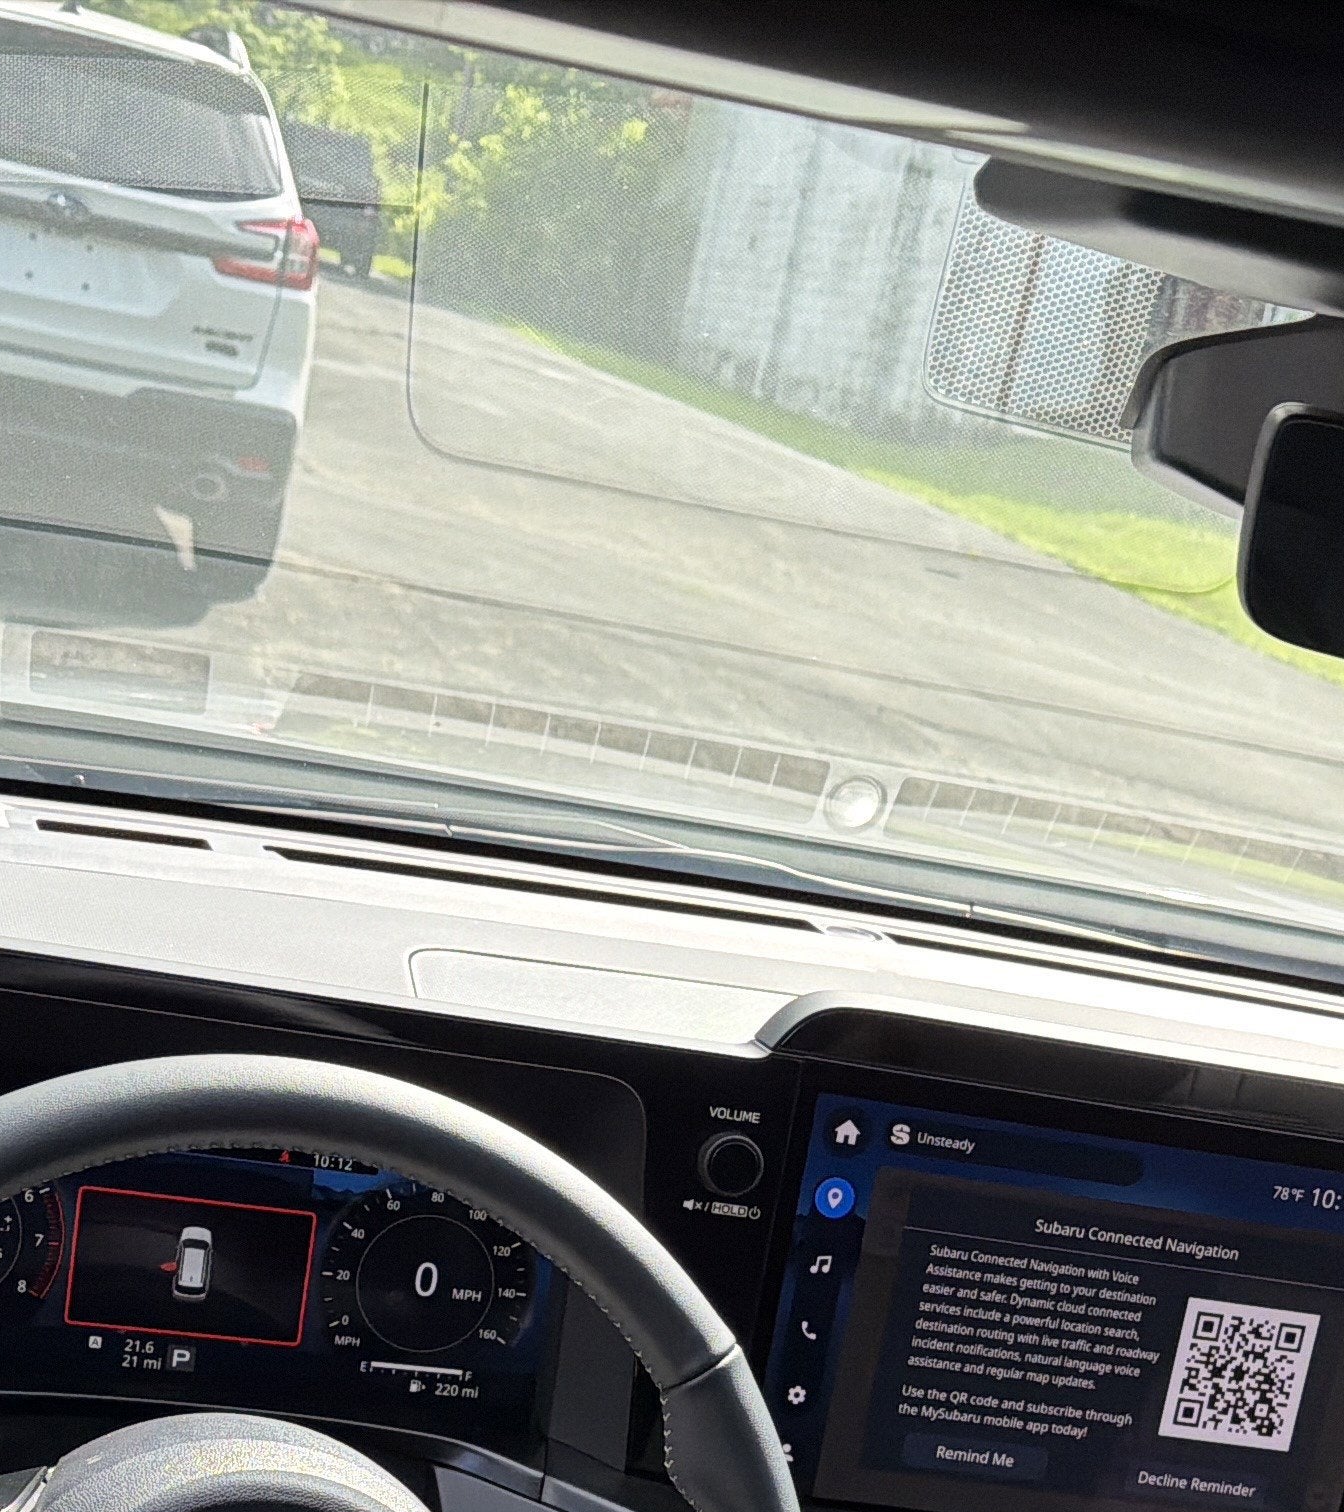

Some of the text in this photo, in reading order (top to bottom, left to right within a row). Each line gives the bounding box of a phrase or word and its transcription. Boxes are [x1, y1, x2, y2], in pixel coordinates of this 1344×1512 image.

[709, 1105, 761, 1125] VOLUME
[917, 1131, 976, 1155] Unsteady
[313, 1154, 354, 1171] 10:12
[24, 1189, 34, 1203] 6
[431, 1192, 445, 1203] 80
[387, 1200, 401, 1211] 60
[711, 1202, 748, 1217] HOLD
[468, 1209, 488, 1221] 100
[34, 1233, 44, 1247] 7
[351, 1228, 365, 1239] 40
[1034, 1218, 1240, 1261] Subaru Connected Navigation
[493, 1245, 511, 1257] 120
[929, 1244, 1140, 1286] Subaru Connected Navigation with Voice
[336, 1270, 350, 1281] 20
[414, 1262, 482, 1302] 0 MPH
[17, 1280, 27, 1293] 8
[925, 1262, 1157, 1306] Assistance makes getting to your destination
[497, 1288, 516, 1299] 140
[922, 1283, 1143, 1323] easier and safer. Dynamic cloud connected
[341, 1315, 350, 1326] 0
[918, 1301, 1140, 1342] services include a powerful location search,
[334, 1335, 361, 1348] MPH
[478, 1329, 497, 1340] 160
[914, 1317, 1161, 1365] destination routing with live traffic and roadway
[124, 1339, 154, 1354] 21.6
[121, 1354, 162, 1371] 21 mi
[172, 1349, 191, 1368] P
[911, 1334, 1141, 1378] incident notifications, natural language voice
[360, 1360, 367, 1373] E
[907, 1355, 1096, 1390] assistance and regular map updates.
[465, 1371, 473, 1383] F
[434, 1383, 479, 1399] 220 mi
[901, 1383, 1133, 1428] Use the QR code and subscribe through
[898, 1402, 1089, 1440] the MySubaru mobile app today!
[935, 1445, 1015, 1468] Remind Me
[1137, 1470, 1257, 1498] Decline Reminder
